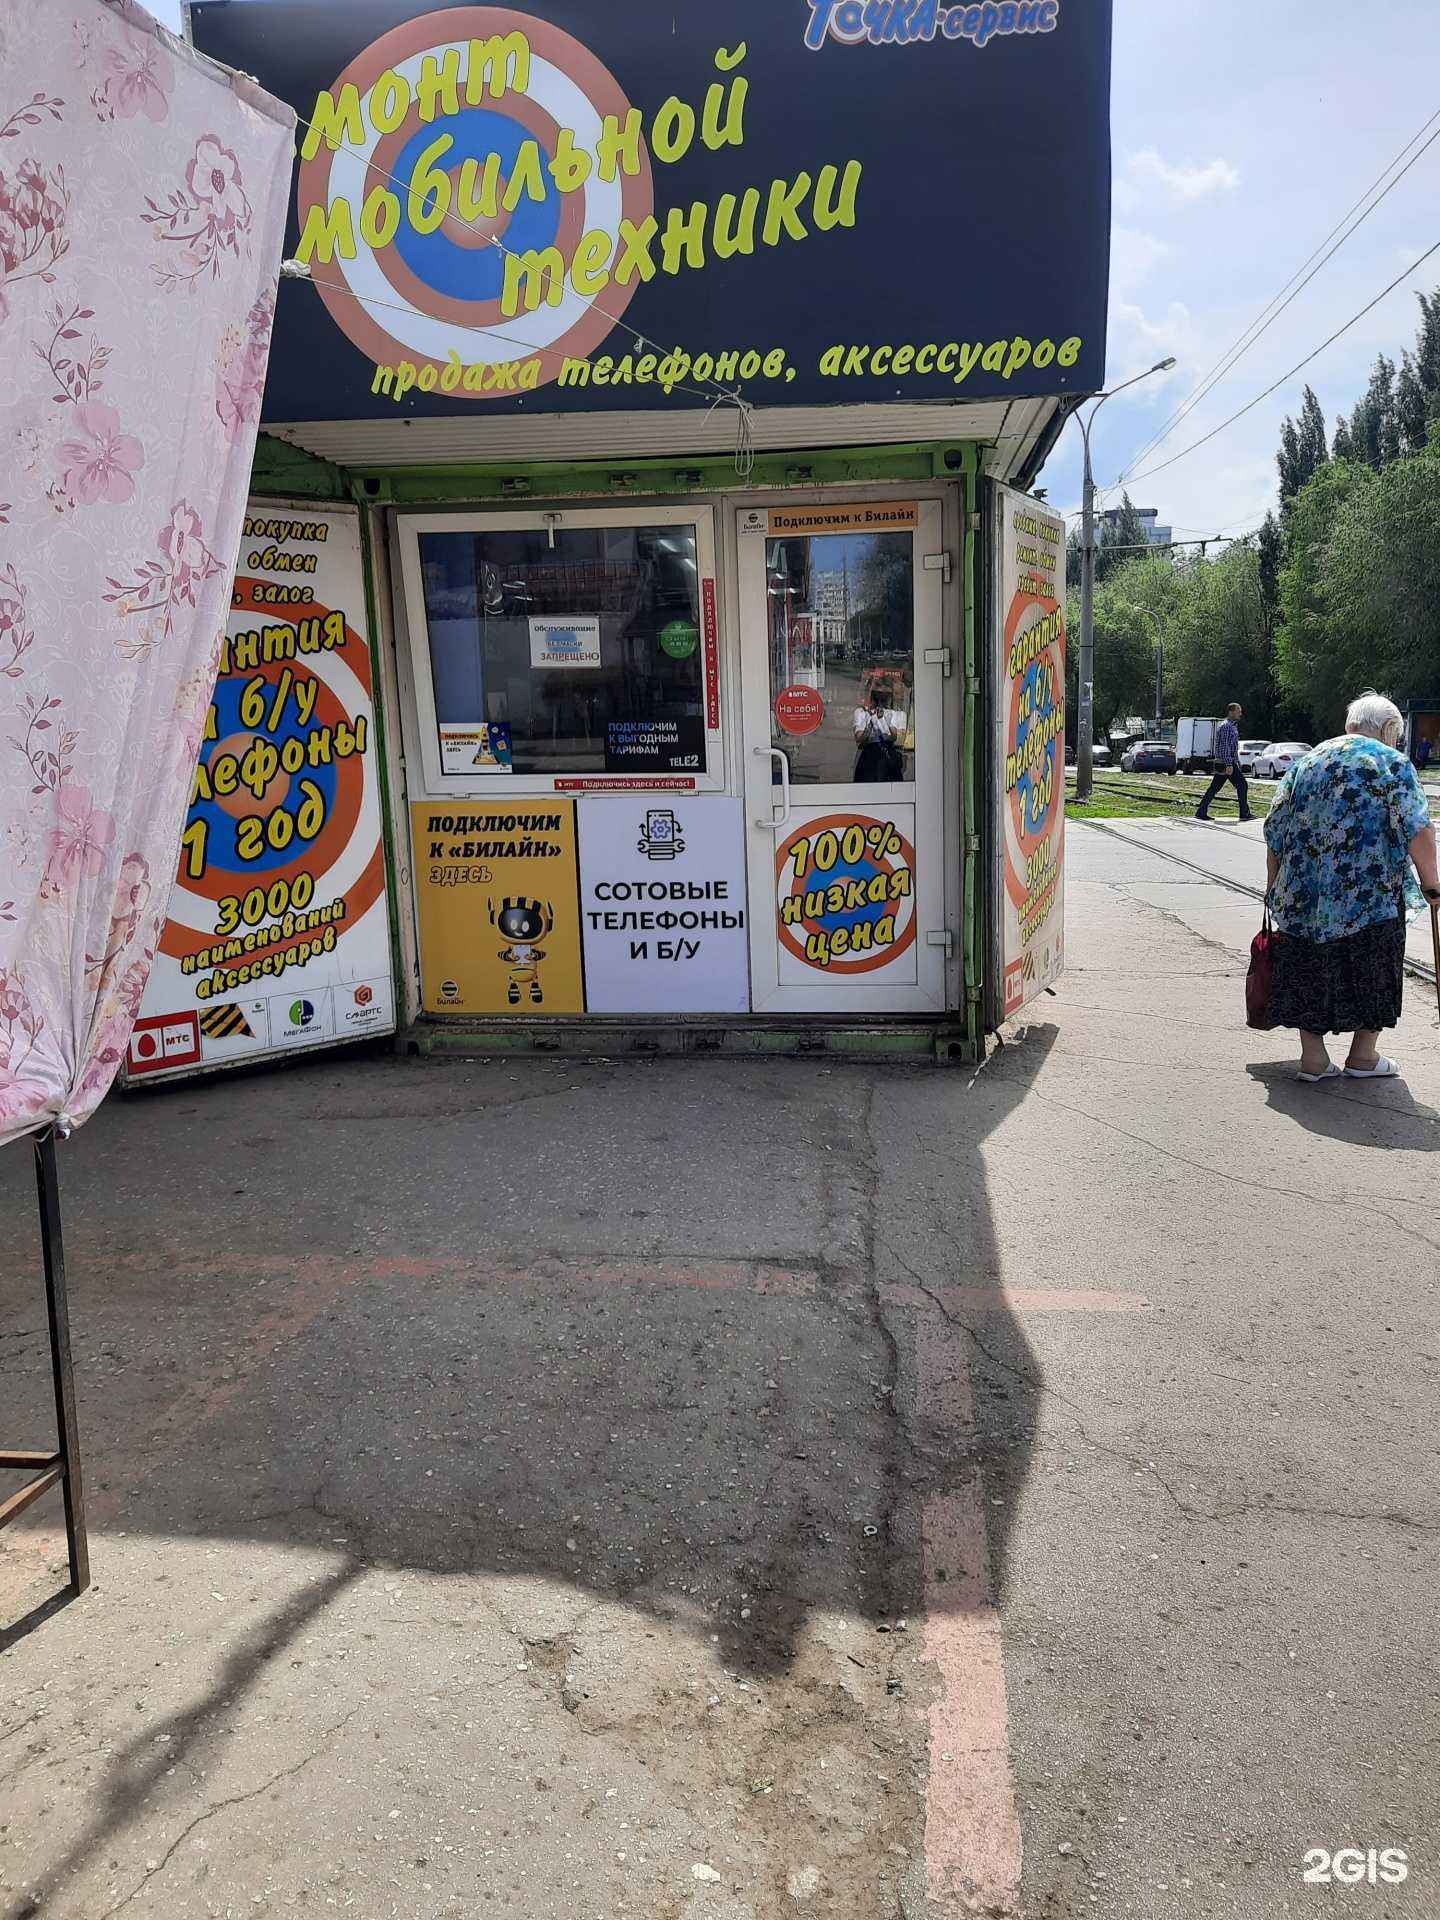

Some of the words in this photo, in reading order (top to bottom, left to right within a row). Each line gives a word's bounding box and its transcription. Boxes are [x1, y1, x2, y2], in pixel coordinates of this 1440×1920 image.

[293, 31, 530, 161] монт
[295, 41, 748, 263] мобильной
[501, 160, 863, 317] техники
[371, 349, 541, 401] продажа
[558, 345, 797, 393] телефонов,
[819, 335, 1082, 383] аксессуаров
[242, 517, 329, 544] покупка
[773, 514, 850, 528] Подключим
[864, 508, 914, 523] Билайн
[247, 545, 317, 573] обмен
[252, 584, 314, 604] залог
[1010, 605, 1061, 680] гарантия
[779, 704, 792, 713] На
[608, 722, 677, 733] ПОДКЛЮЧИМ
[609, 734, 615, 743] К
[618, 733, 679, 744] ВЫГОДНЫМ
[609, 745, 659, 755] ТАРИФАМ
[669, 754, 699, 767] TELE2
[182, 820, 209, 879] 1
[238, 778, 326, 861] год
[426, 814, 562, 836] ПОДКЛЮЧИМ
[429, 842, 443, 858] К
[449, 836, 562, 859] «БИЛАЙН»
[789, 821, 902, 878] 100%
[1026, 834, 1049, 889] 3000
[429, 865, 493, 886] ЗДЕСЬ
[216, 873, 315, 935] 3000
[594, 881, 729, 901] СОТОВЫЕ
[781, 867, 912, 925] низкая
[587, 910, 745, 930] ТЕЛЕФОНЫ
[181, 898, 346, 975] наименований
[630, 941, 648, 959] И
[656, 937, 701, 961] Б/У
[805, 915, 897, 967] цена
[196, 926, 337, 999] аксессуаров
[165, 1033, 190, 1046] МТС
